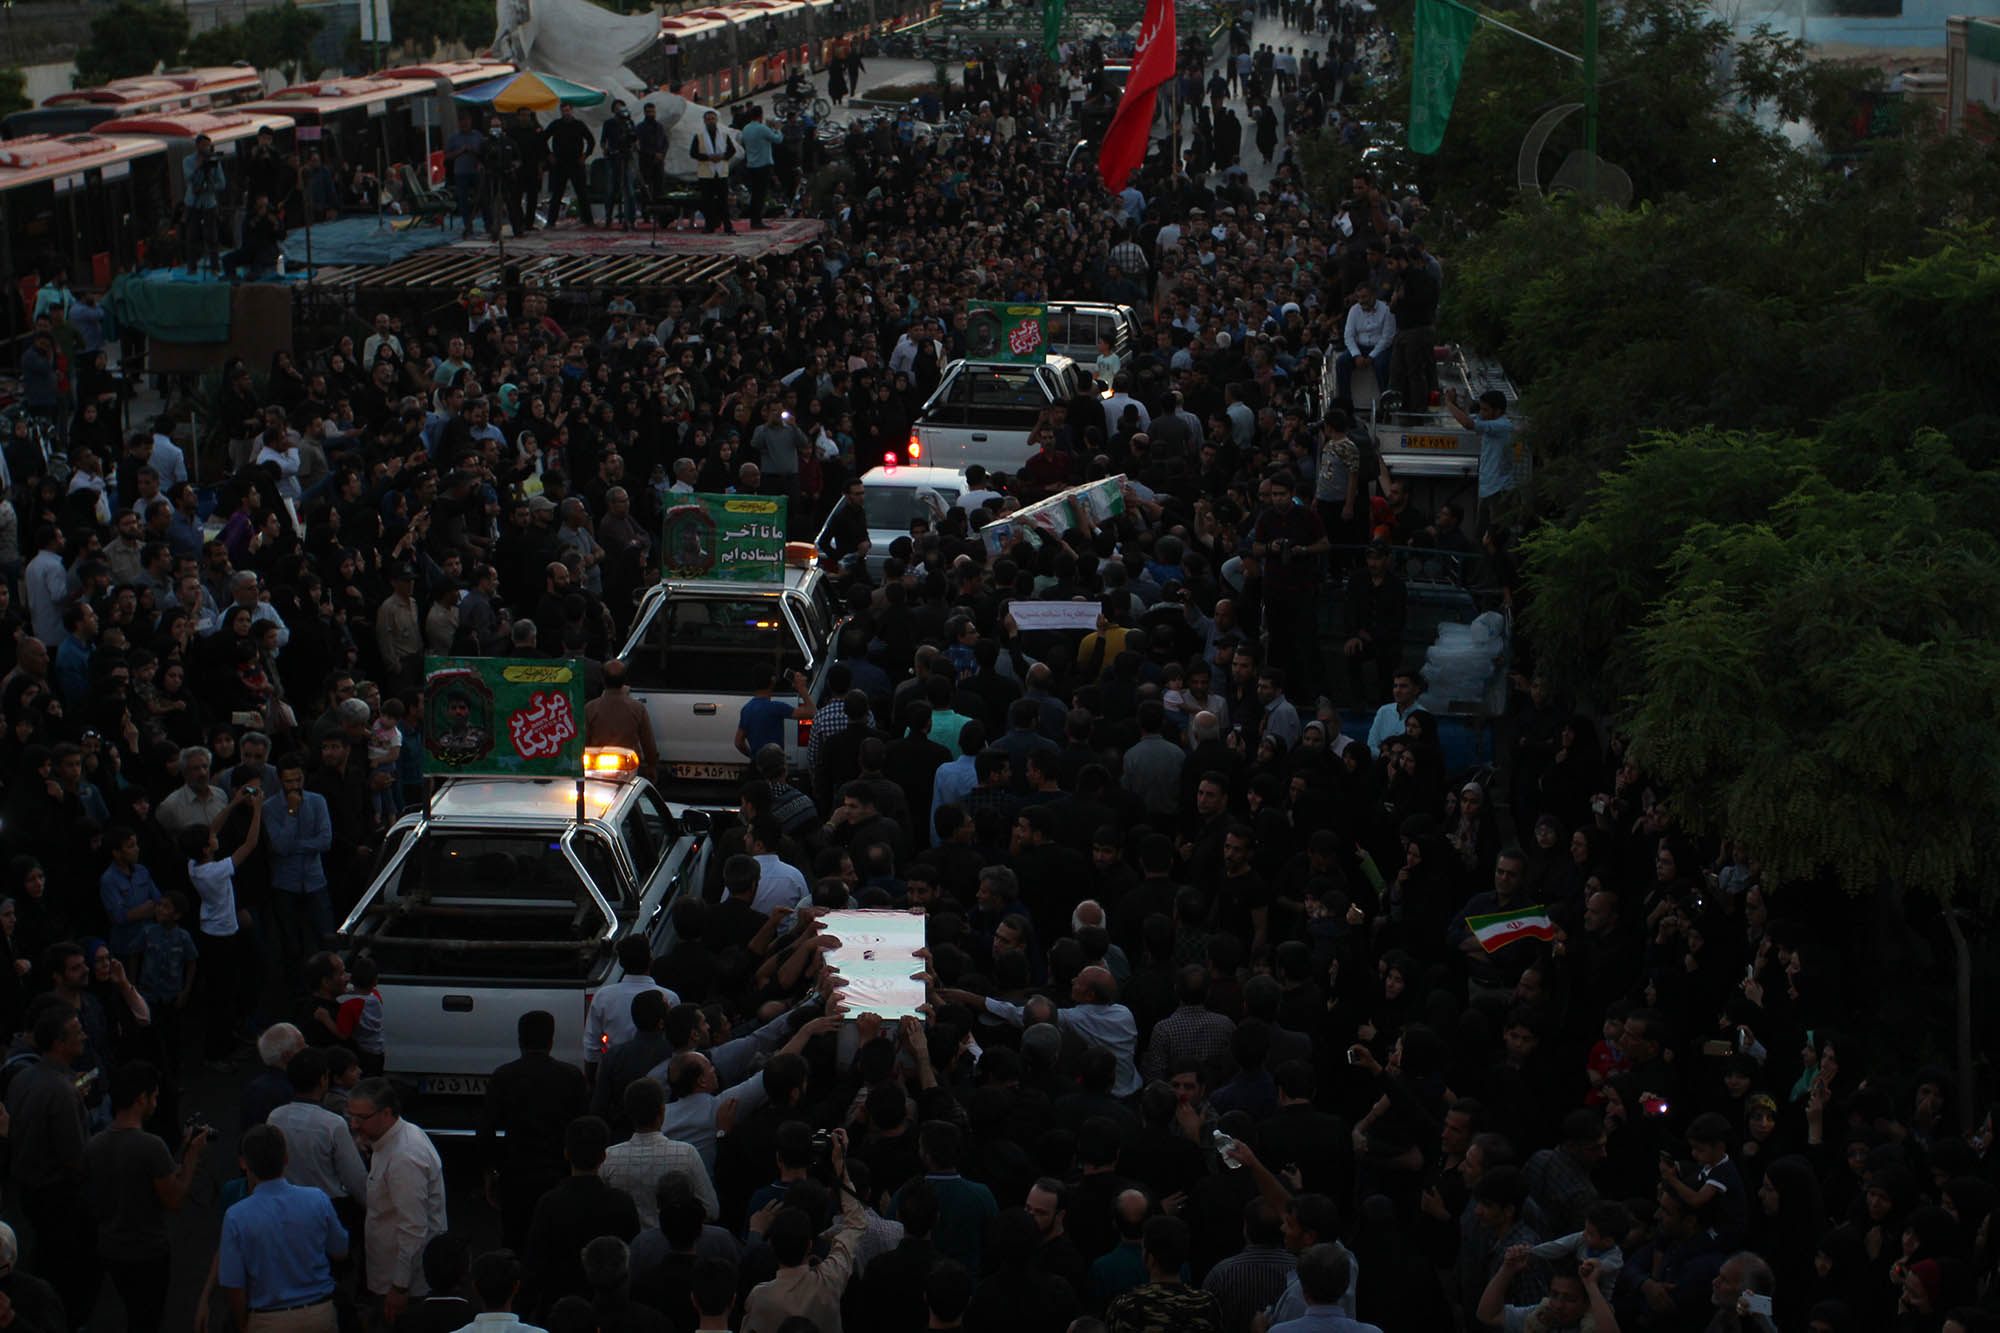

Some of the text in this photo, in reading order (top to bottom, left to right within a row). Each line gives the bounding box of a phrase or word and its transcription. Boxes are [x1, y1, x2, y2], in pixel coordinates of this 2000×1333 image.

[722, 523, 784, 542] ما تا آخر
[721, 546, 784, 566] ایستاده ایم
[525, 693, 565, 720] مرگ
[511, 713, 527, 738] بر
